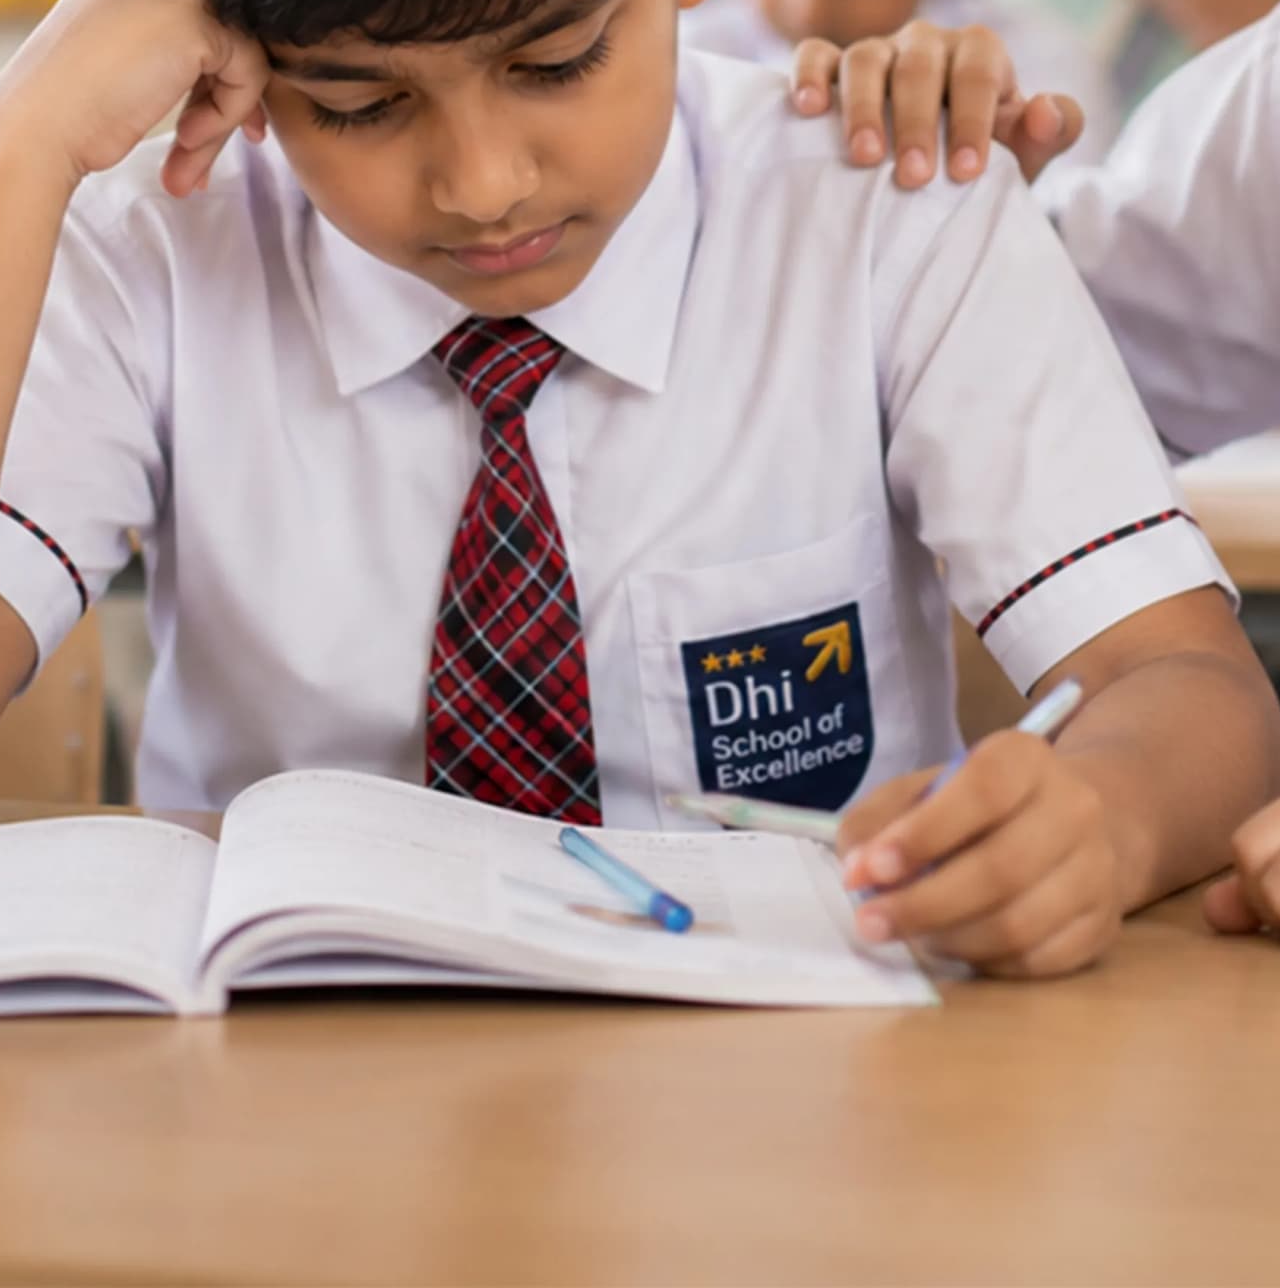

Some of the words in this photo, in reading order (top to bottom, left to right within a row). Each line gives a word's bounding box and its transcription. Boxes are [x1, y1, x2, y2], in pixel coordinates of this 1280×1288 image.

[705, 670, 793, 727] Dhi
[712, 717, 812, 761] School
[817, 703, 844, 734] of
[716, 733, 864, 789] Excellence
